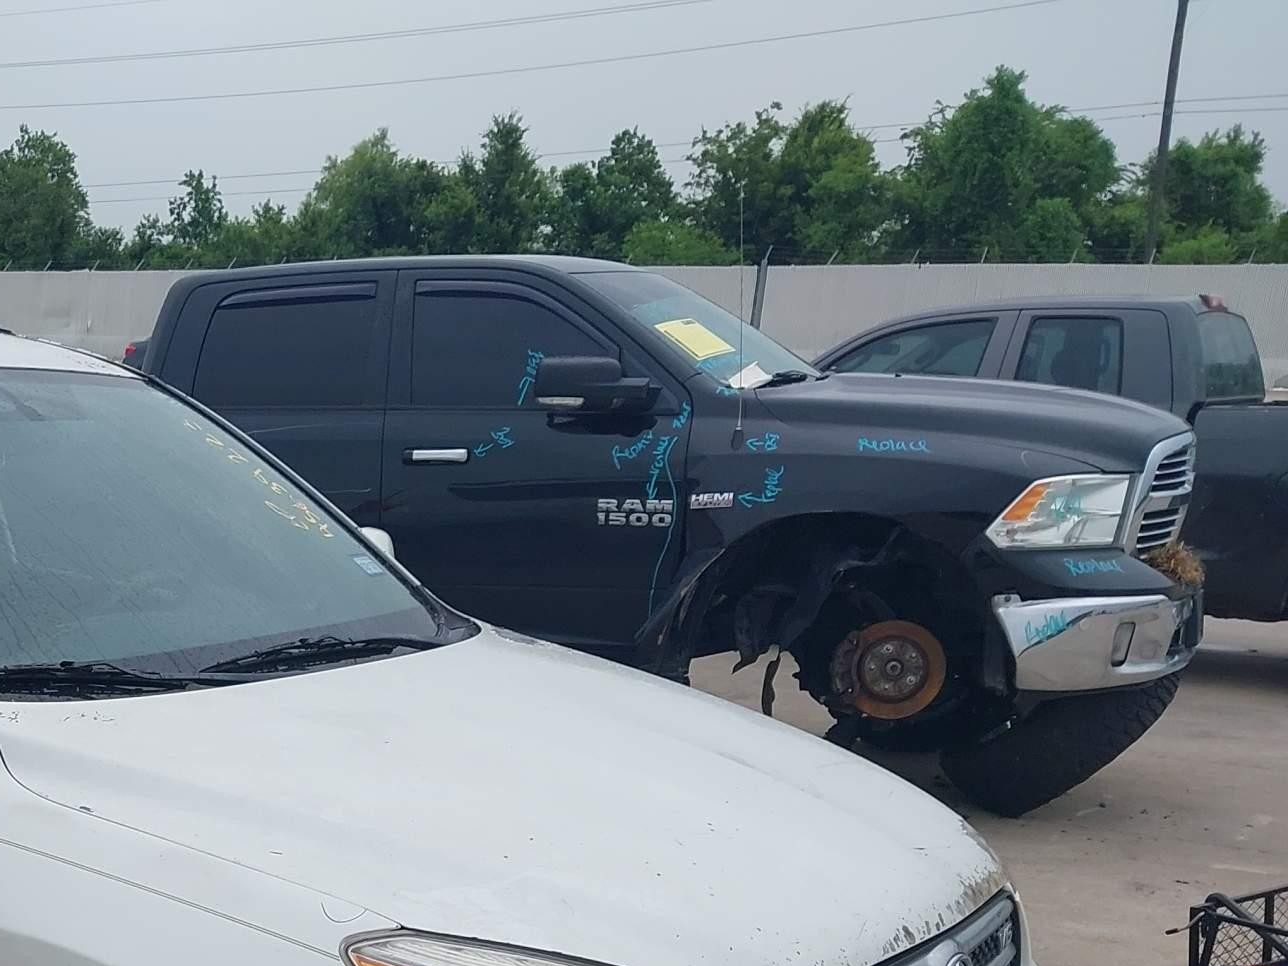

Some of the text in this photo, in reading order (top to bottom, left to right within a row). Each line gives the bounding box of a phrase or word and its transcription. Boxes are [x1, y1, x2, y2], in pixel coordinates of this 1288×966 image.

[691, 492, 734, 503] HEMI
[597, 498, 673, 512] RAM
[597, 513, 672, 527] 1500
